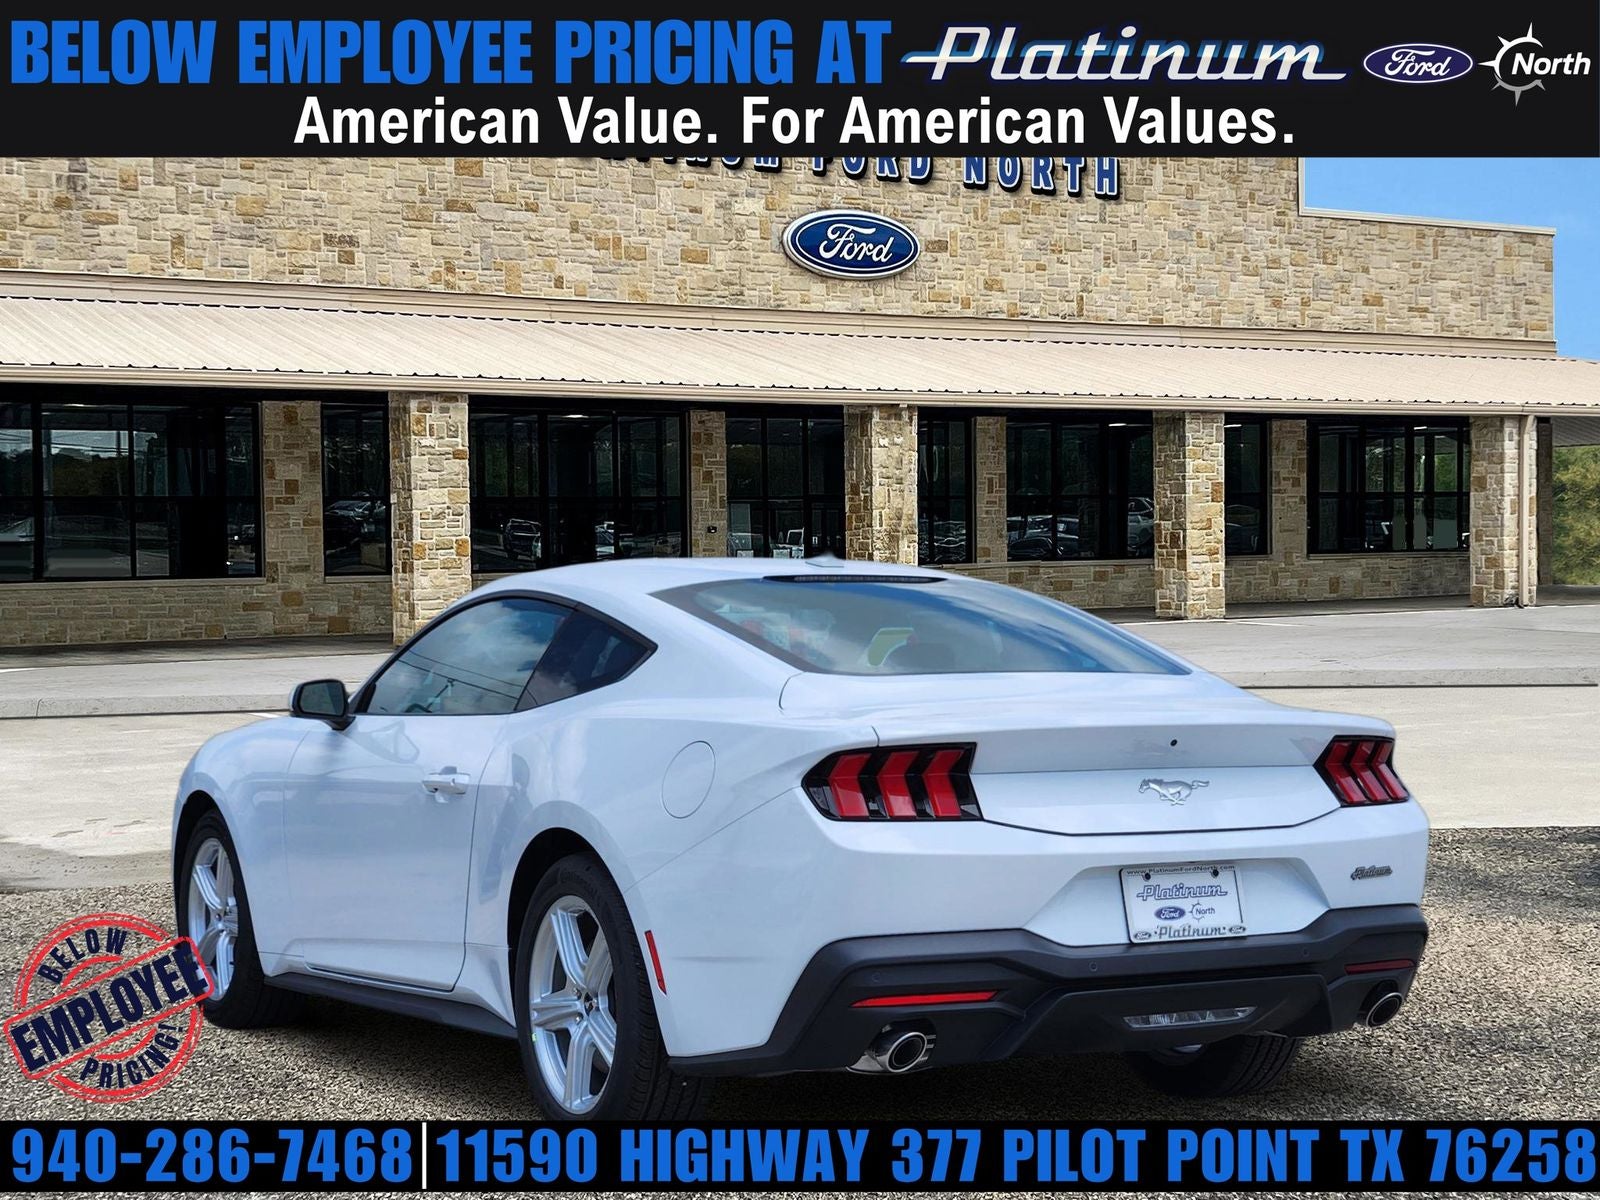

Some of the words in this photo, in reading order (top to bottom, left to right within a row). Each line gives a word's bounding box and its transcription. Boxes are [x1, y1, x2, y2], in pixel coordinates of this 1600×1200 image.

[963, 156, 1121, 197] NORTH
[818, 222, 895, 263] Ford
[1136, 882, 1228, 901] Platinum
[1159, 907, 1181, 919] Ford
[1195, 906, 1216, 915] North
[1155, 924, 1228, 939] Platinum
